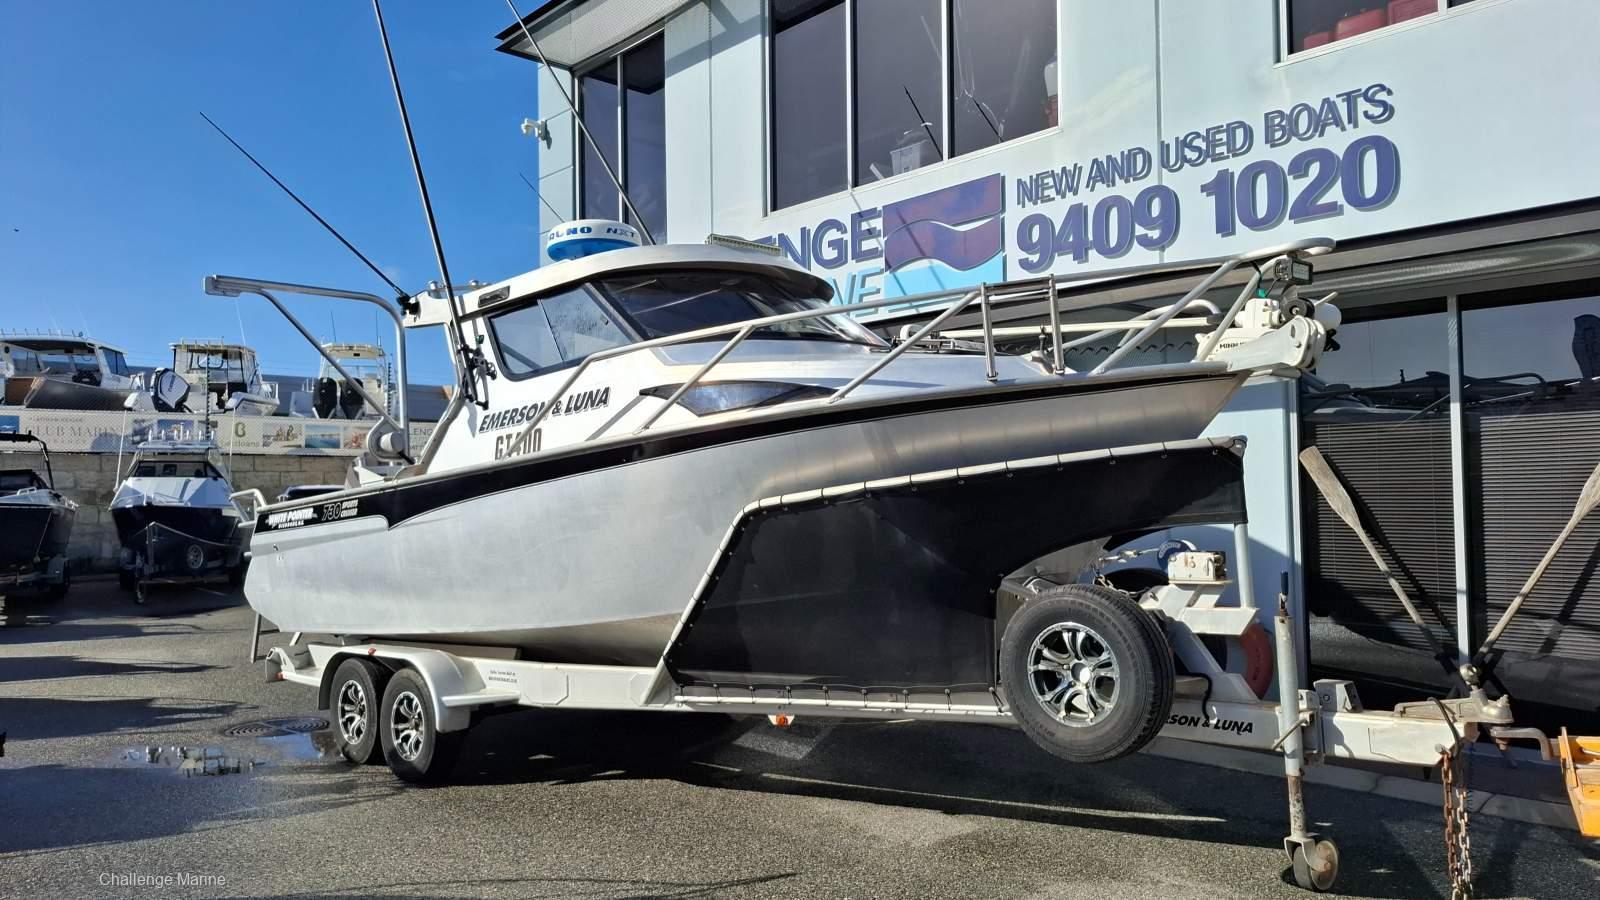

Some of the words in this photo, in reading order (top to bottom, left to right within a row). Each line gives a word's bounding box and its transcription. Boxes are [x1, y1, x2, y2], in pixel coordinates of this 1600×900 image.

[1016, 161, 1083, 208] NEW
[1085, 146, 1153, 192] AND
[1160, 120, 1255, 174] USED
[1263, 83, 1395, 150] BOATS
[1016, 184, 1181, 274] 9409
[1200, 135, 1401, 239] 1020
[750, 206, 884, 272] NGE
[552, 400, 563, 416] &
[564, 386, 611, 415] LUNA
[69, 426, 120, 438] MARIN
[321, 502, 342, 521] 730
[341, 508, 358, 517] CRUISER
[342, 499, 359, 509] SPORTS
[268, 512, 287, 526] WHITE
[287, 507, 314, 521] POINTER
[1167, 714, 1200, 728] SON
[1202, 719, 1210, 728] &
[1214, 719, 1253, 735] LUNA
